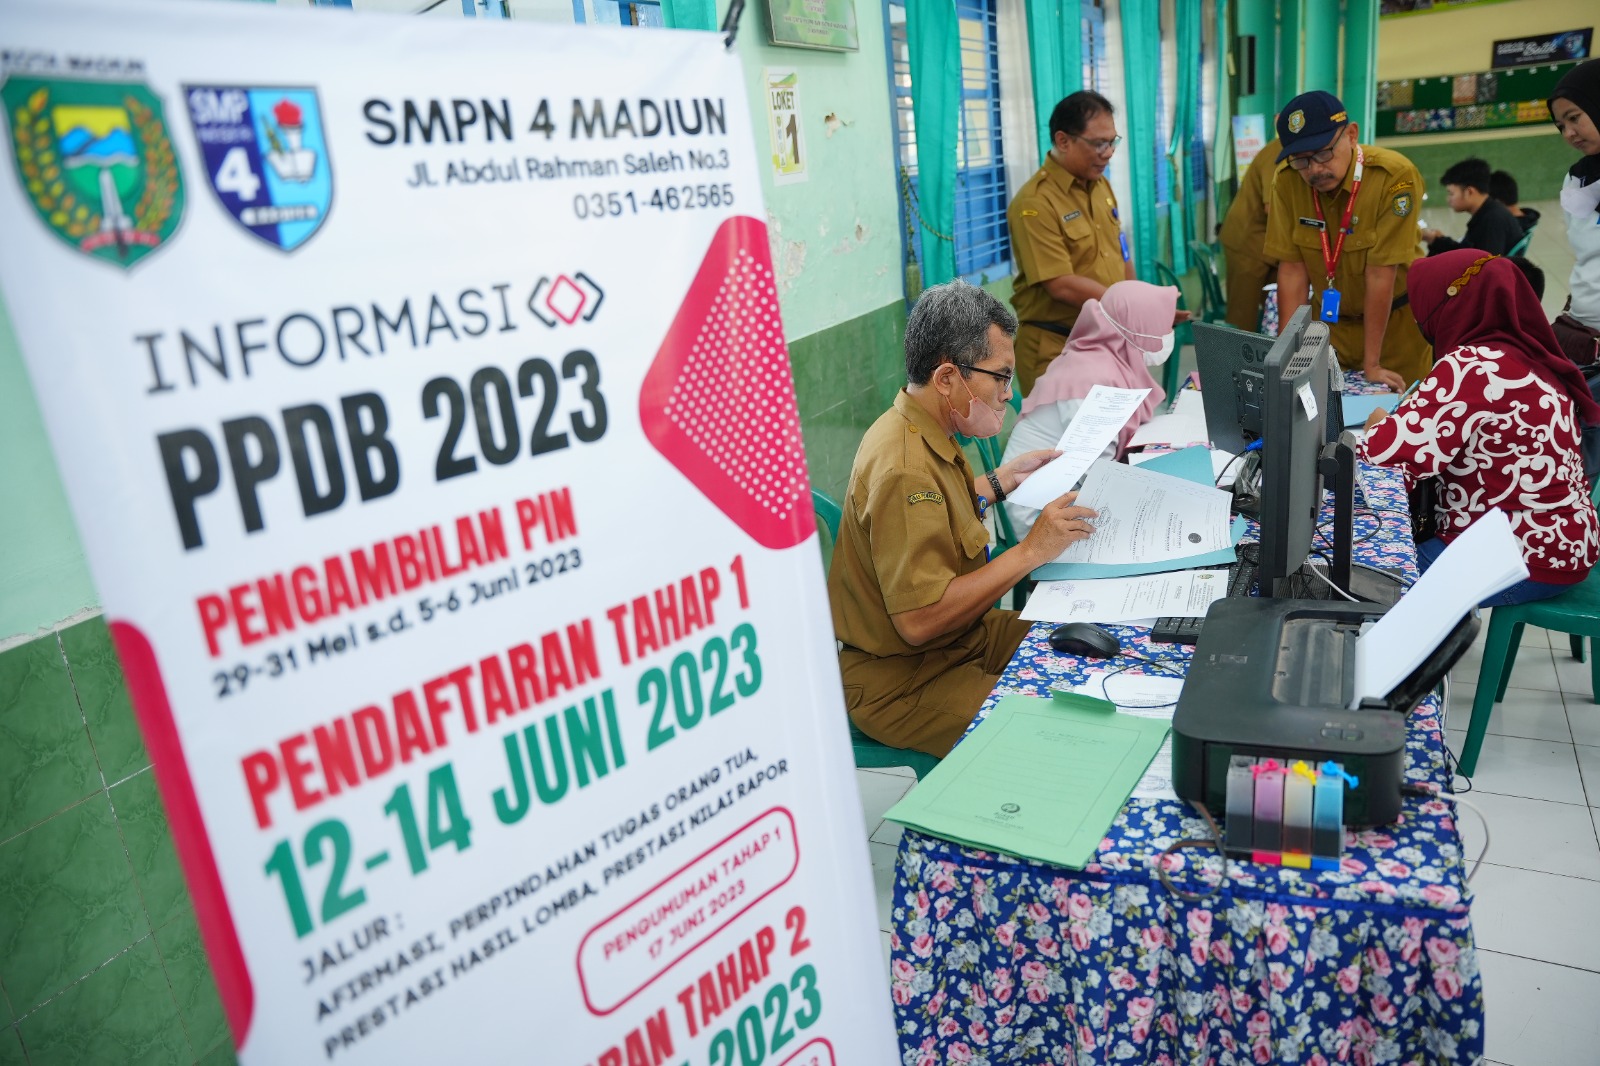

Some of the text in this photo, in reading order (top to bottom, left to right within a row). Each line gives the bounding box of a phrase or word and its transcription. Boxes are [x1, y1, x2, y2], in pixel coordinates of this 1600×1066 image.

[189, 89, 249, 124] SMP
[362, 98, 727, 146] SMPN 4 MADIUN
[771, 91, 794, 110] LOKET
[785, 113, 800, 164] 1
[214, 146, 261, 202] 4
[445, 156, 521, 184] Abdul
[525, 155, 619, 179] Rahman
[624, 150, 684, 175] Saleh
[689, 149, 730, 171] No.3
[574, 183, 735, 219] 0351-462565
[134, 283, 518, 394] INFORMASI
[156, 349, 609, 551] PPDB 2023
[195, 485, 578, 659] PENGAMBILAN PIN
[213, 649, 299, 699] 29-31
[308, 624, 357, 663] Mei
[420, 594, 460, 622] 5-6
[469, 567, 519, 605] Juni
[525, 547, 583, 586] 2023
[239, 553, 750, 830] PENDAFTARAN TAHAP 1
[263, 621, 764, 941] 12-14 JUNI 2023
[316, 746, 760, 1022] AFIRMASI, PERPINDAHAN TUGAS ORANG TUA,
[324, 759, 790, 1059] PRESTASI HASIL LOMBA, PRESTASI NILAI RAPOR
[603, 825, 783, 960] PENGUMUMAN TAHAP 1
[669, 908, 707, 946] JUNI
[708, 878, 747, 917] 2023
[302, 916, 391, 985] JALUR
[676, 925, 776, 1038] TAHAP
[785, 904, 812, 957] 2
